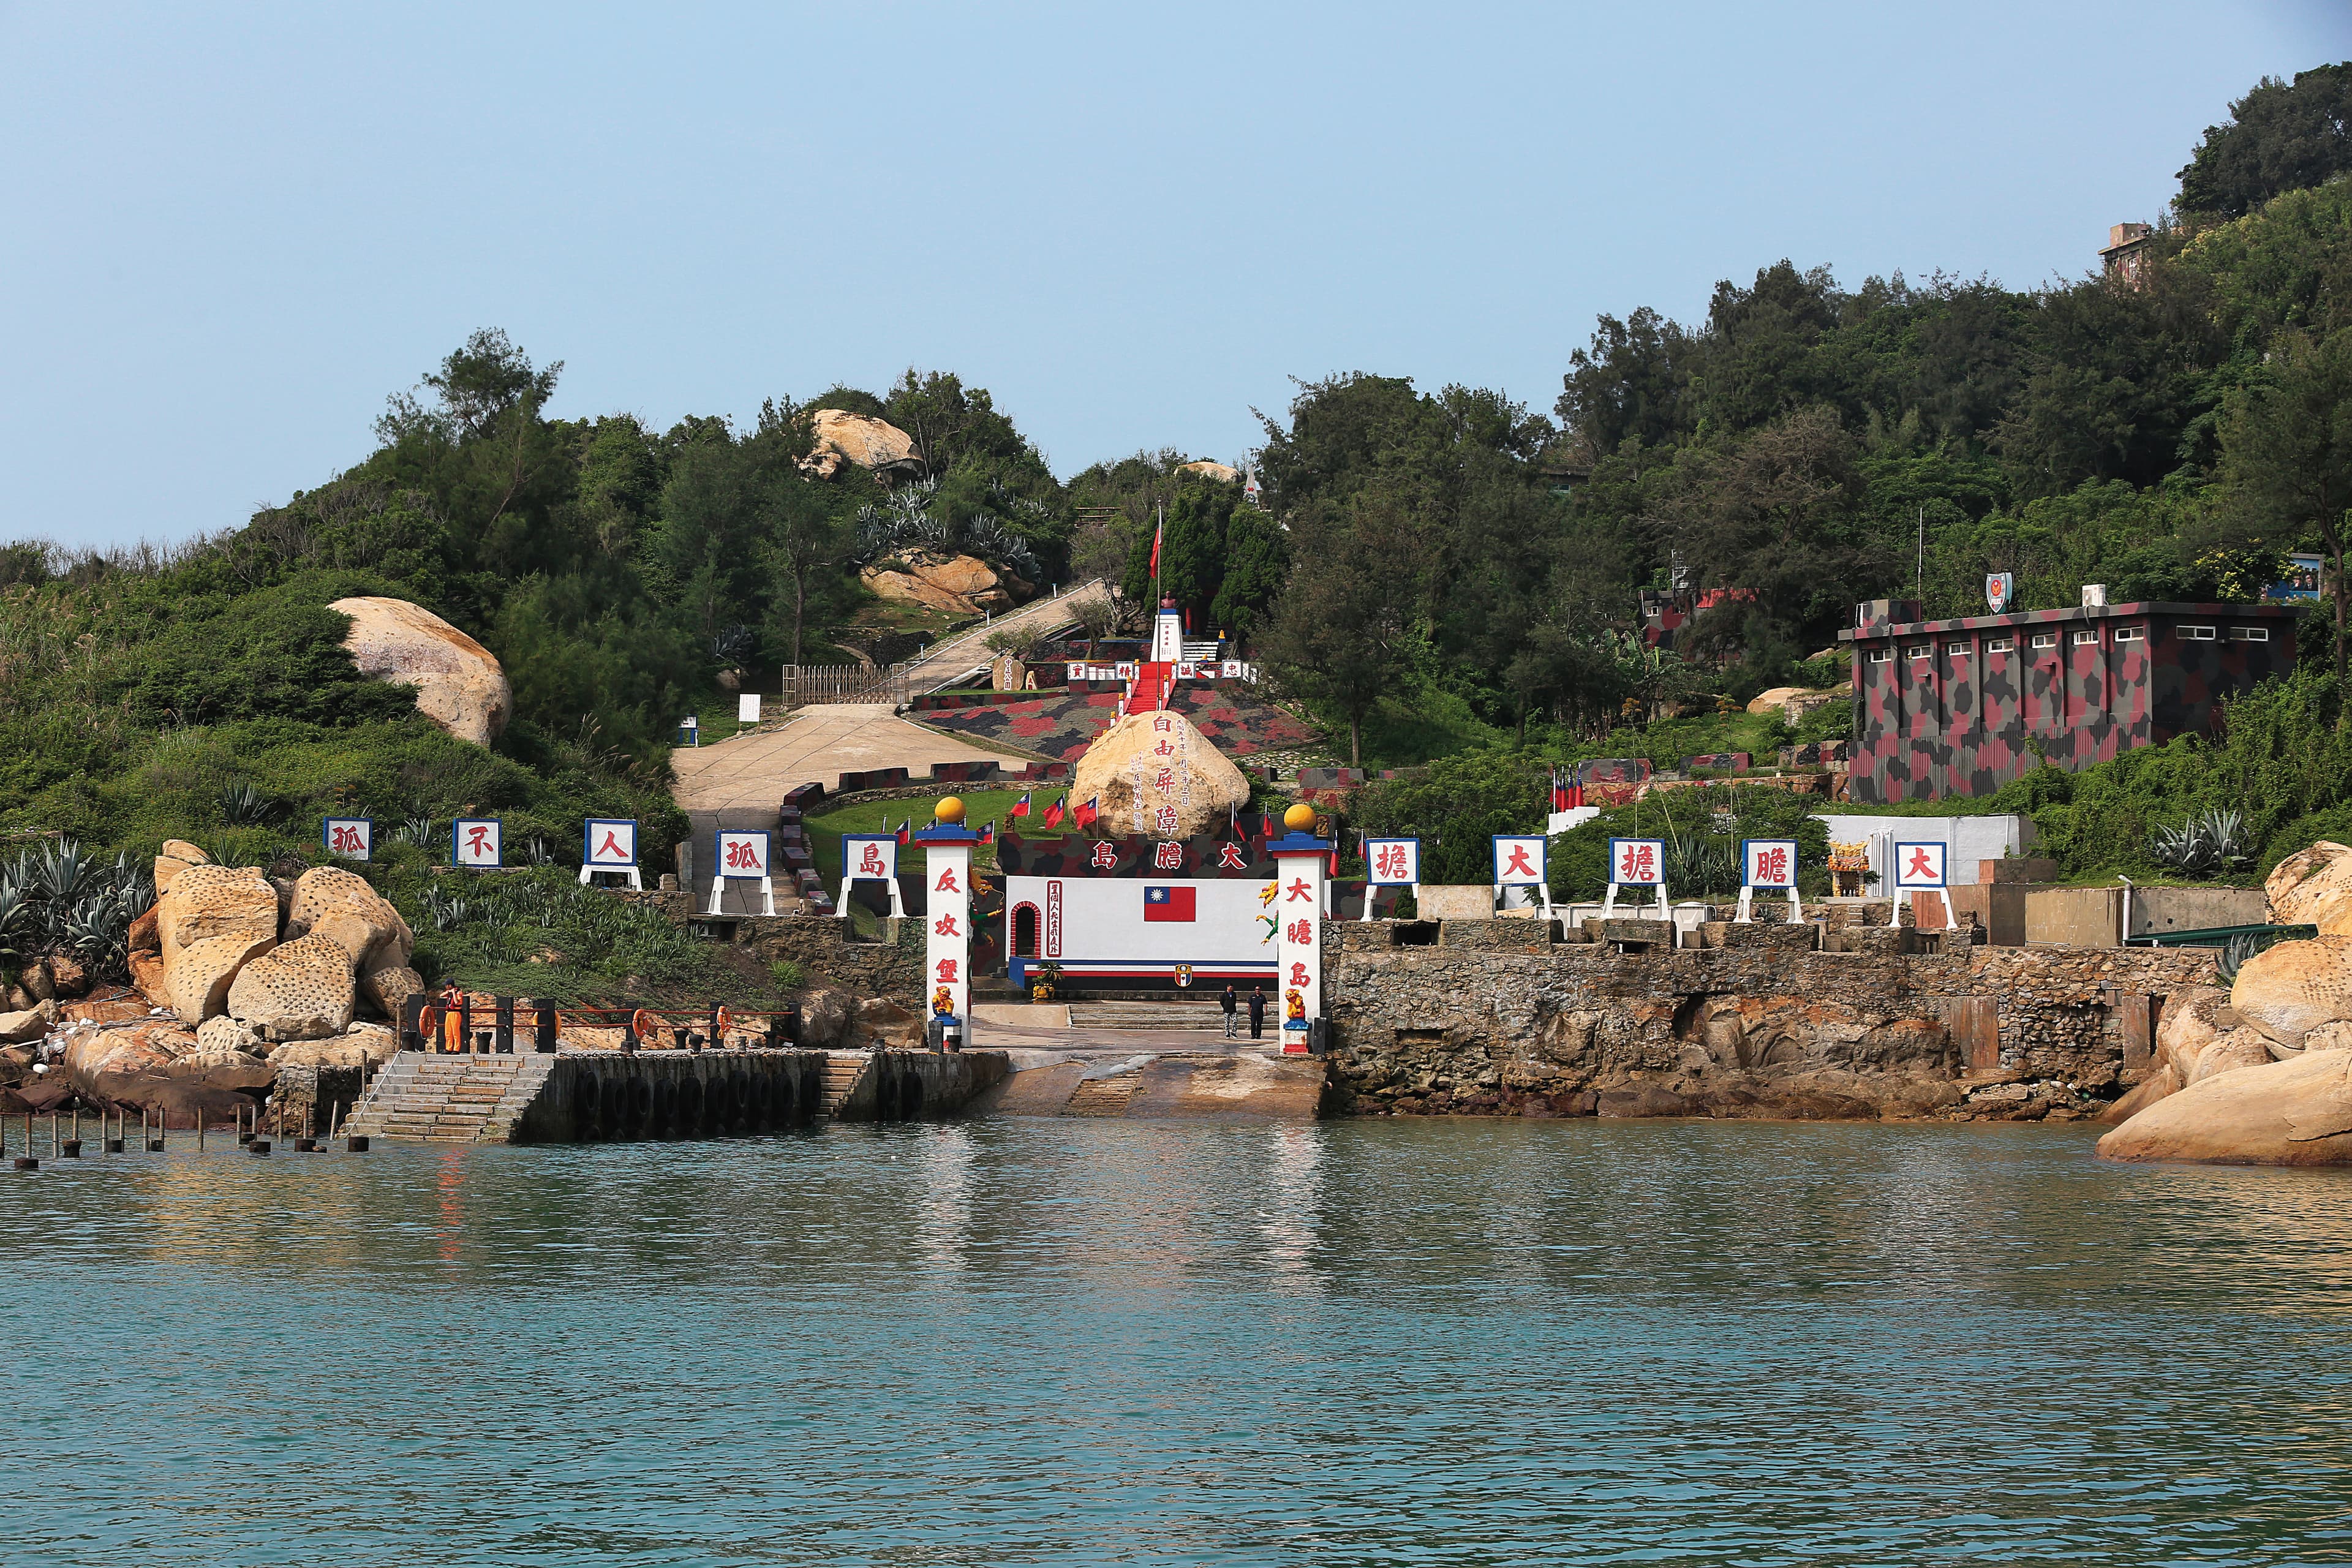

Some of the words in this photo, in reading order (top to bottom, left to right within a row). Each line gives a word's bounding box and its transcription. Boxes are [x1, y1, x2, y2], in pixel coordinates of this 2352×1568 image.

[1072, 664, 1083, 677] 實
[1119, 666, 1131, 677] 精
[1181, 665, 1192, 677] 誠
[1226, 664, 1237, 676] 忠
[1153, 716, 1179, 836] 自由屏障
[333, 826, 366, 852] 孤
[465, 826, 494, 857] 不
[595, 831, 628, 857] 人
[726, 841, 762, 869] 孤
[860, 843, 886, 877] 島
[1376, 845, 1408, 879] 擔
[1502, 845, 1537, 876] 大
[1621, 845, 1655, 881] 擔
[1755, 847, 1787, 884] 膽
[1904, 847, 1939, 878] 大
[934, 868, 961, 983] 反攻堡
[1286, 877, 1313, 988] 大膽島
